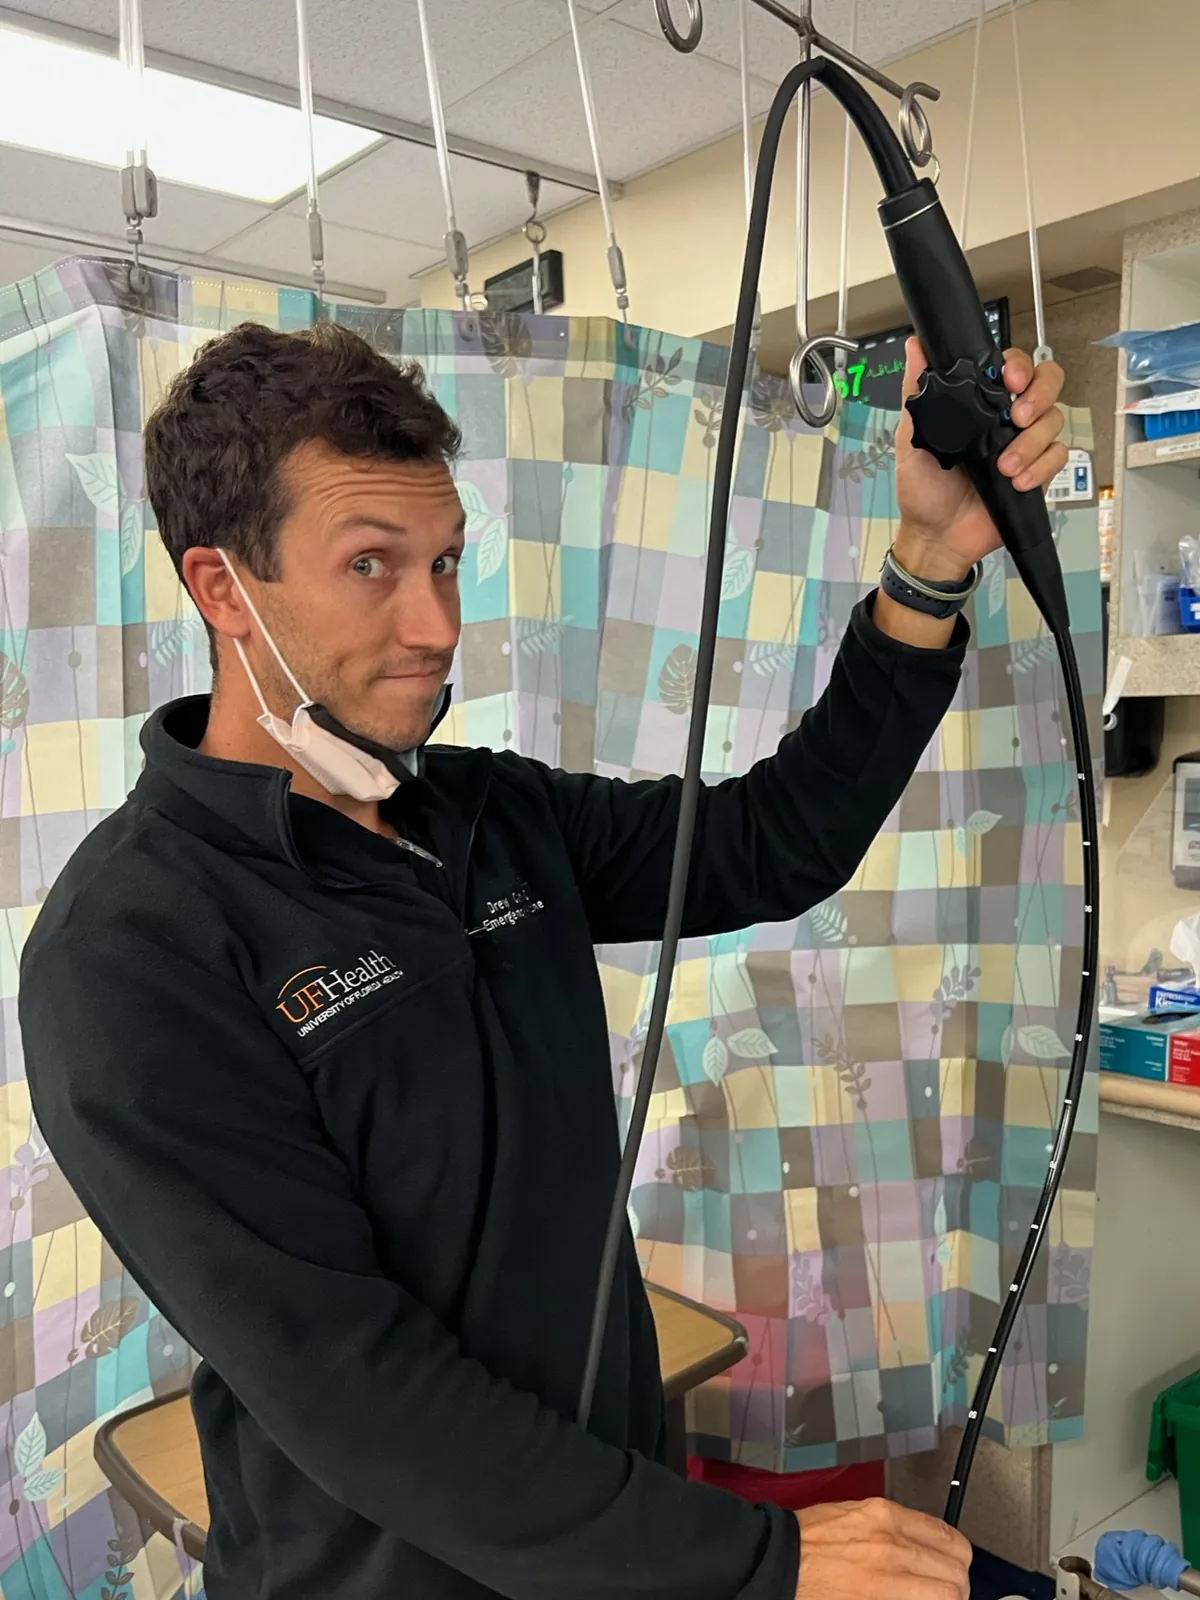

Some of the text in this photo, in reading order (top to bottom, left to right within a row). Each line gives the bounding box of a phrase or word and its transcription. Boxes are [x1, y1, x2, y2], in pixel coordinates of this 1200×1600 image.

[297, 1000, 346, 1038] UNIVERSITY
[343, 994, 357, 1006] OF
[354, 981, 382, 999] FLORIDA
